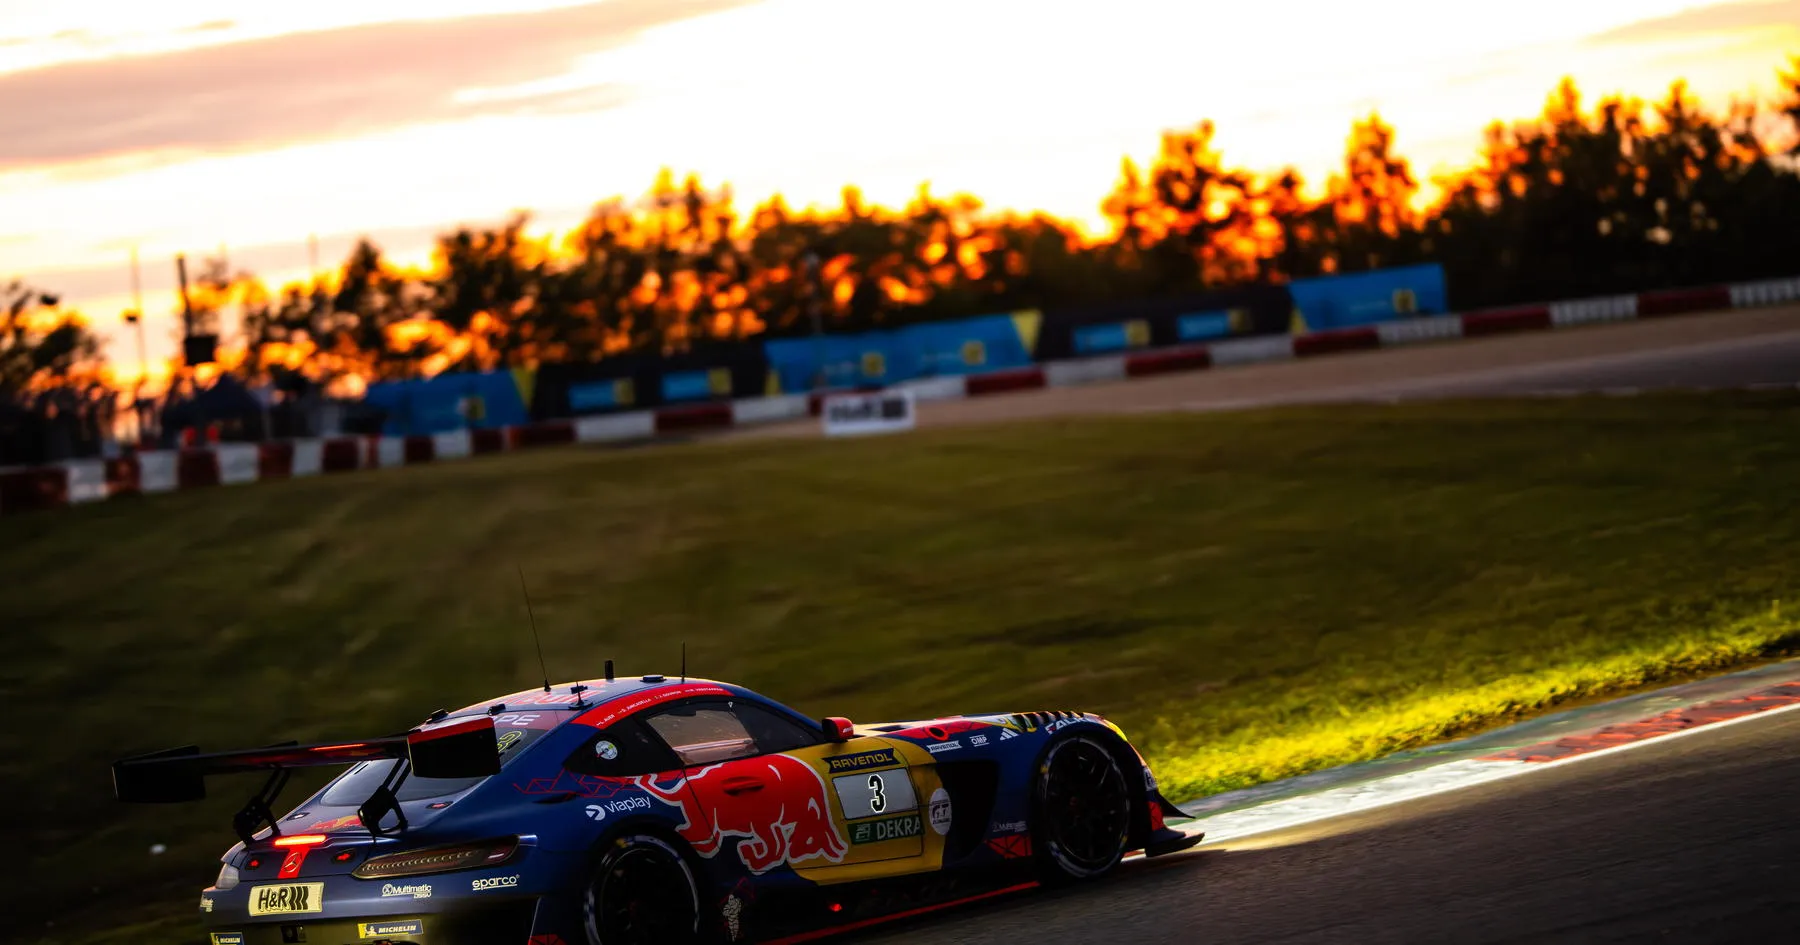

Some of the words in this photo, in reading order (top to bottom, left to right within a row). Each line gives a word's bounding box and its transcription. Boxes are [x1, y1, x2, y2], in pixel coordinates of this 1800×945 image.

[971, 736, 987, 745] OMP
[831, 753, 893, 769] RAVENOL
[867, 774, 887, 813] 3
[604, 796, 652, 813] viaplay
[876, 816, 921, 840] DEKRA
[393, 884, 432, 894] Multimatic
[472, 876, 517, 890] sparco
[258, 888, 288, 910] H&R
[378, 925, 417, 934] MICHELIN
